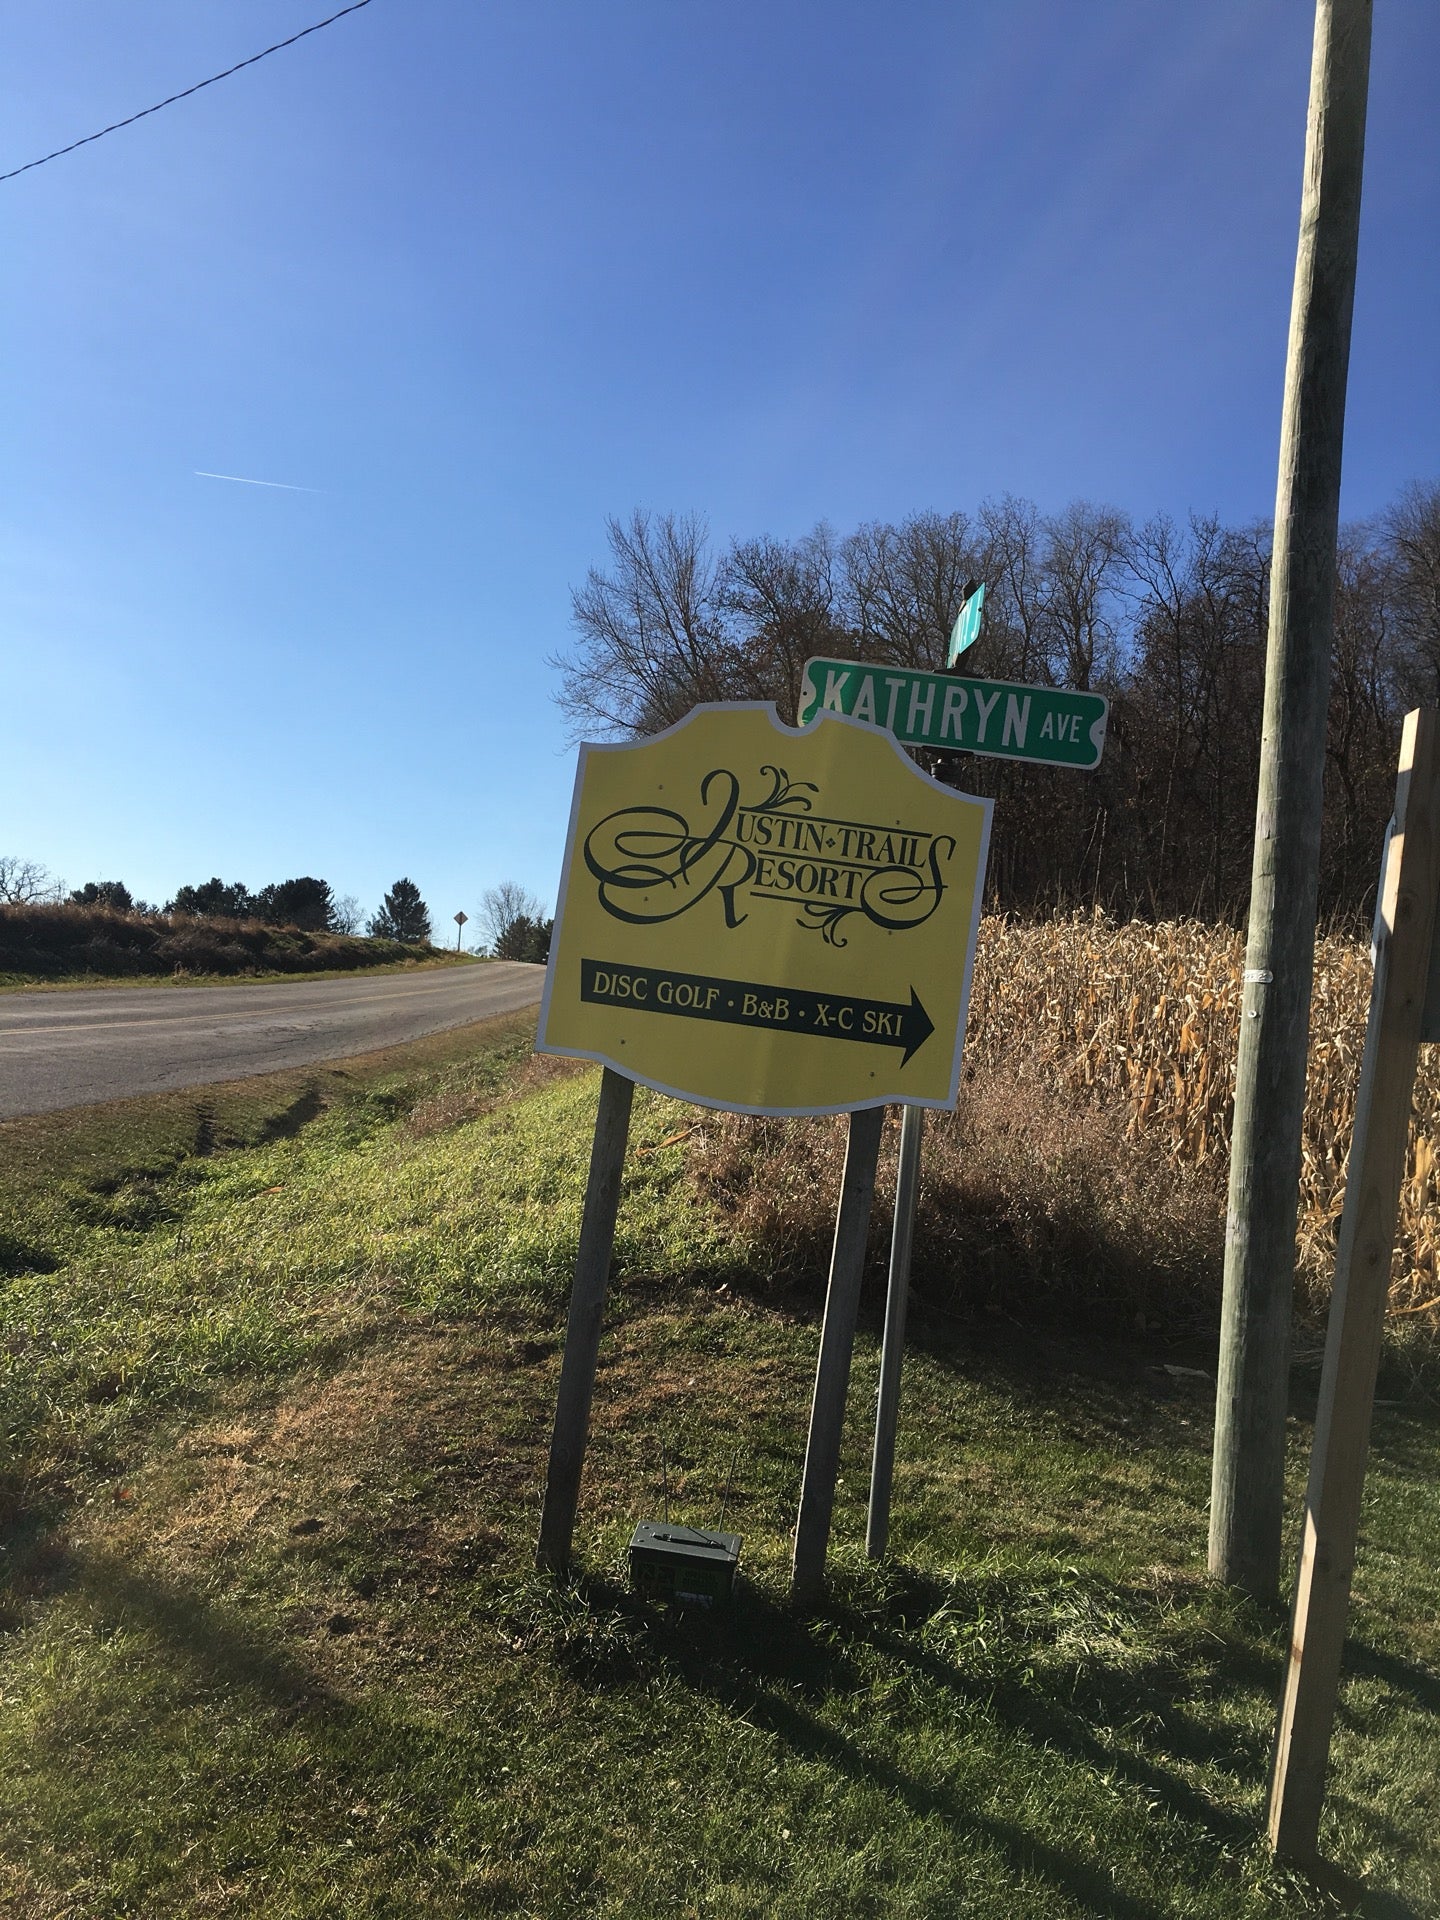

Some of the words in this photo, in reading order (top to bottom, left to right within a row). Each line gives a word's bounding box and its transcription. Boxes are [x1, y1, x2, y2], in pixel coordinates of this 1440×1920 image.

[823, 670, 1032, 749] KATHRYN
[1040, 712, 1083, 743] AVE
[836, 828, 957, 930] TRAILS
[593, 971, 648, 1000] DISC
[656, 981, 720, 1010] GOLF
[741, 993, 790, 1021] B&B
[813, 1003, 854, 1030] X-C
[862, 1010, 903, 1037] SKI
